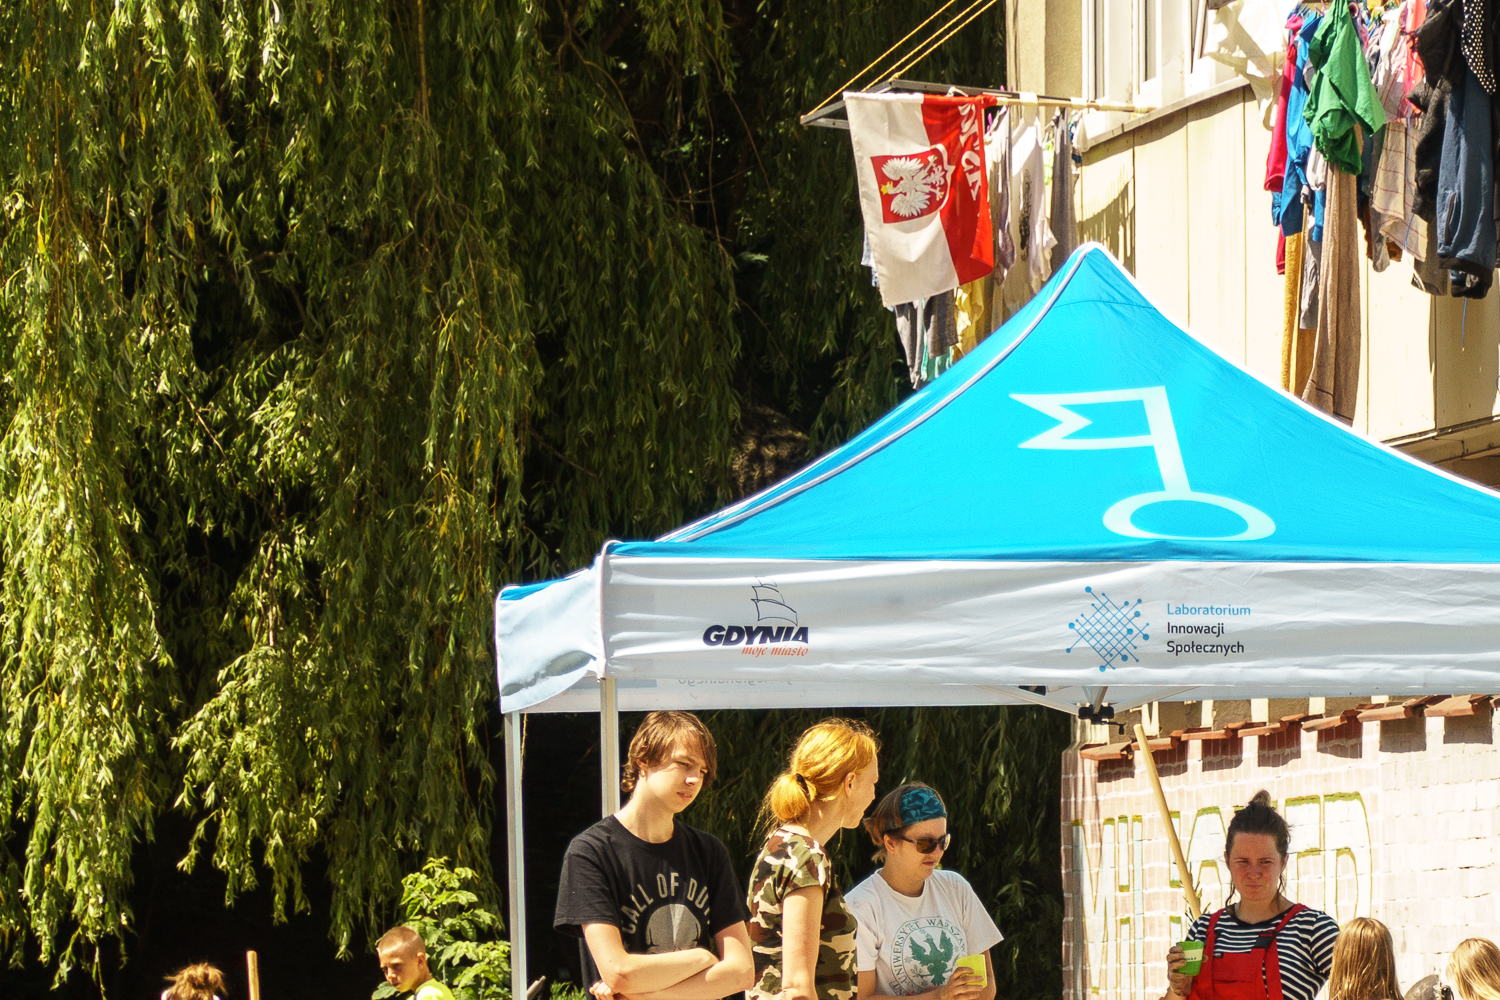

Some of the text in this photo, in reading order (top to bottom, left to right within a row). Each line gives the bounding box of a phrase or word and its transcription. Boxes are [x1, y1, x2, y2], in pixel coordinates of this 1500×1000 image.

[1166, 603, 1251, 616] Laboratorium
[702, 624, 809, 646] GDYNIA
[1167, 622, 1225, 638] Innowacji
[741, 645, 809, 658] moje miasto
[1166, 640, 1245, 657] Społecznych
[621, 872, 711, 935] CALL OF DU
